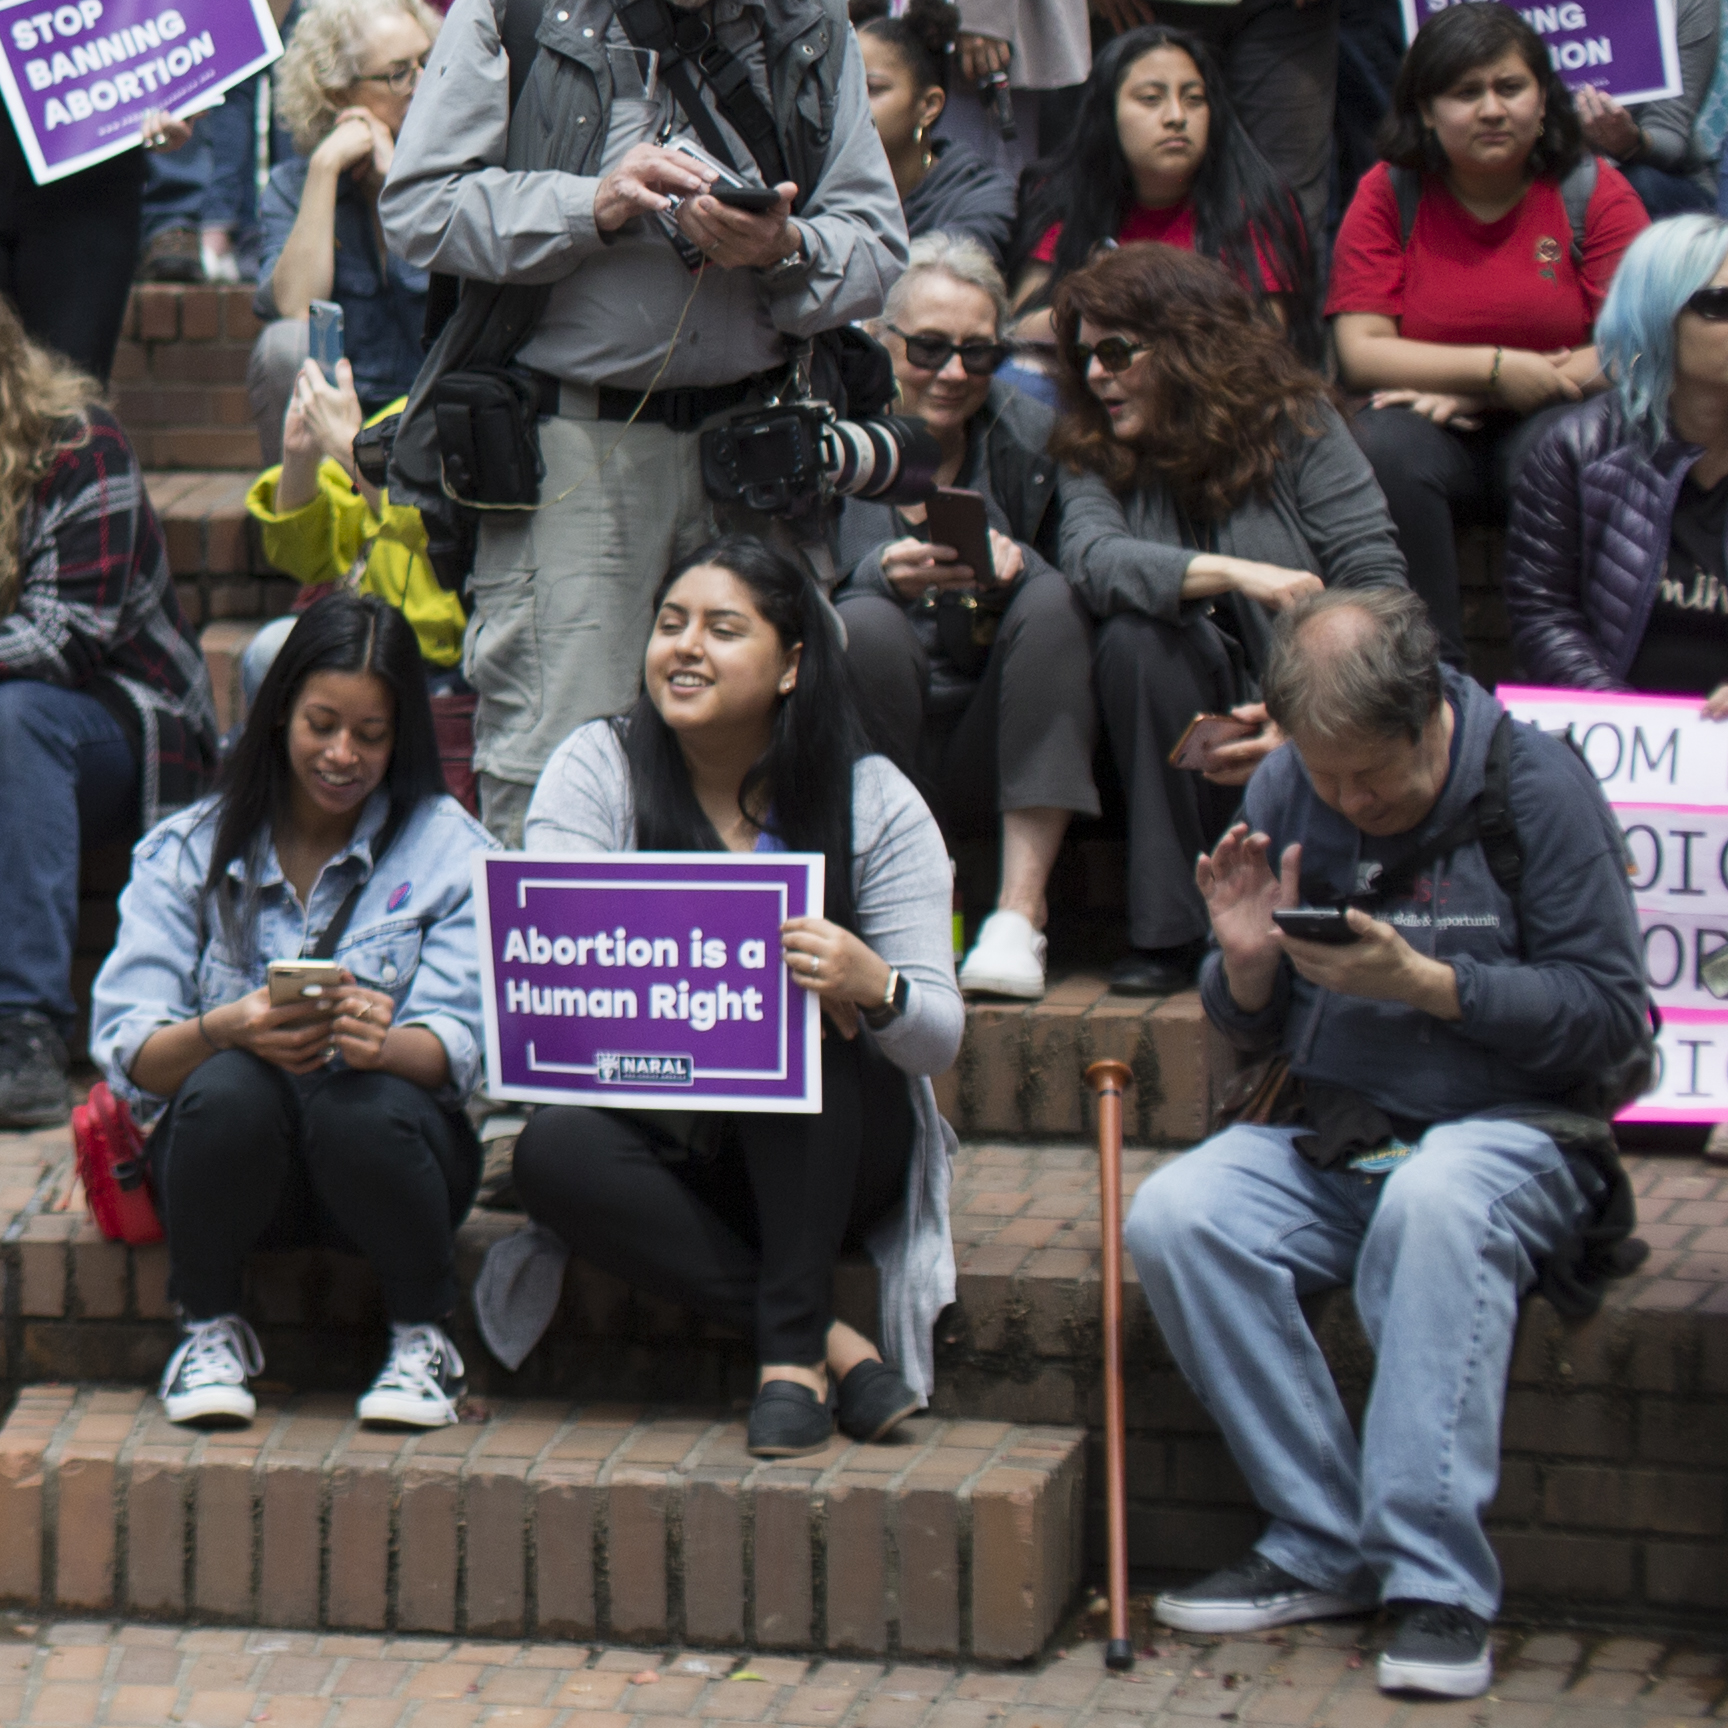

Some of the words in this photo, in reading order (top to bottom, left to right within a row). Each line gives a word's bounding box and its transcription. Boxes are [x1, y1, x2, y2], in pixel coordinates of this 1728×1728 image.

[25, 9, 187, 91] BANNING
[44, 30, 216, 131] ABORTION
[502, 926, 679, 968] Abortion
[690, 927, 728, 969] is
[737, 939, 766, 970] a
[505, 977, 638, 1019] Human
[648, 979, 764, 1032] Right
[623, 1058, 687, 1074] NARAL
